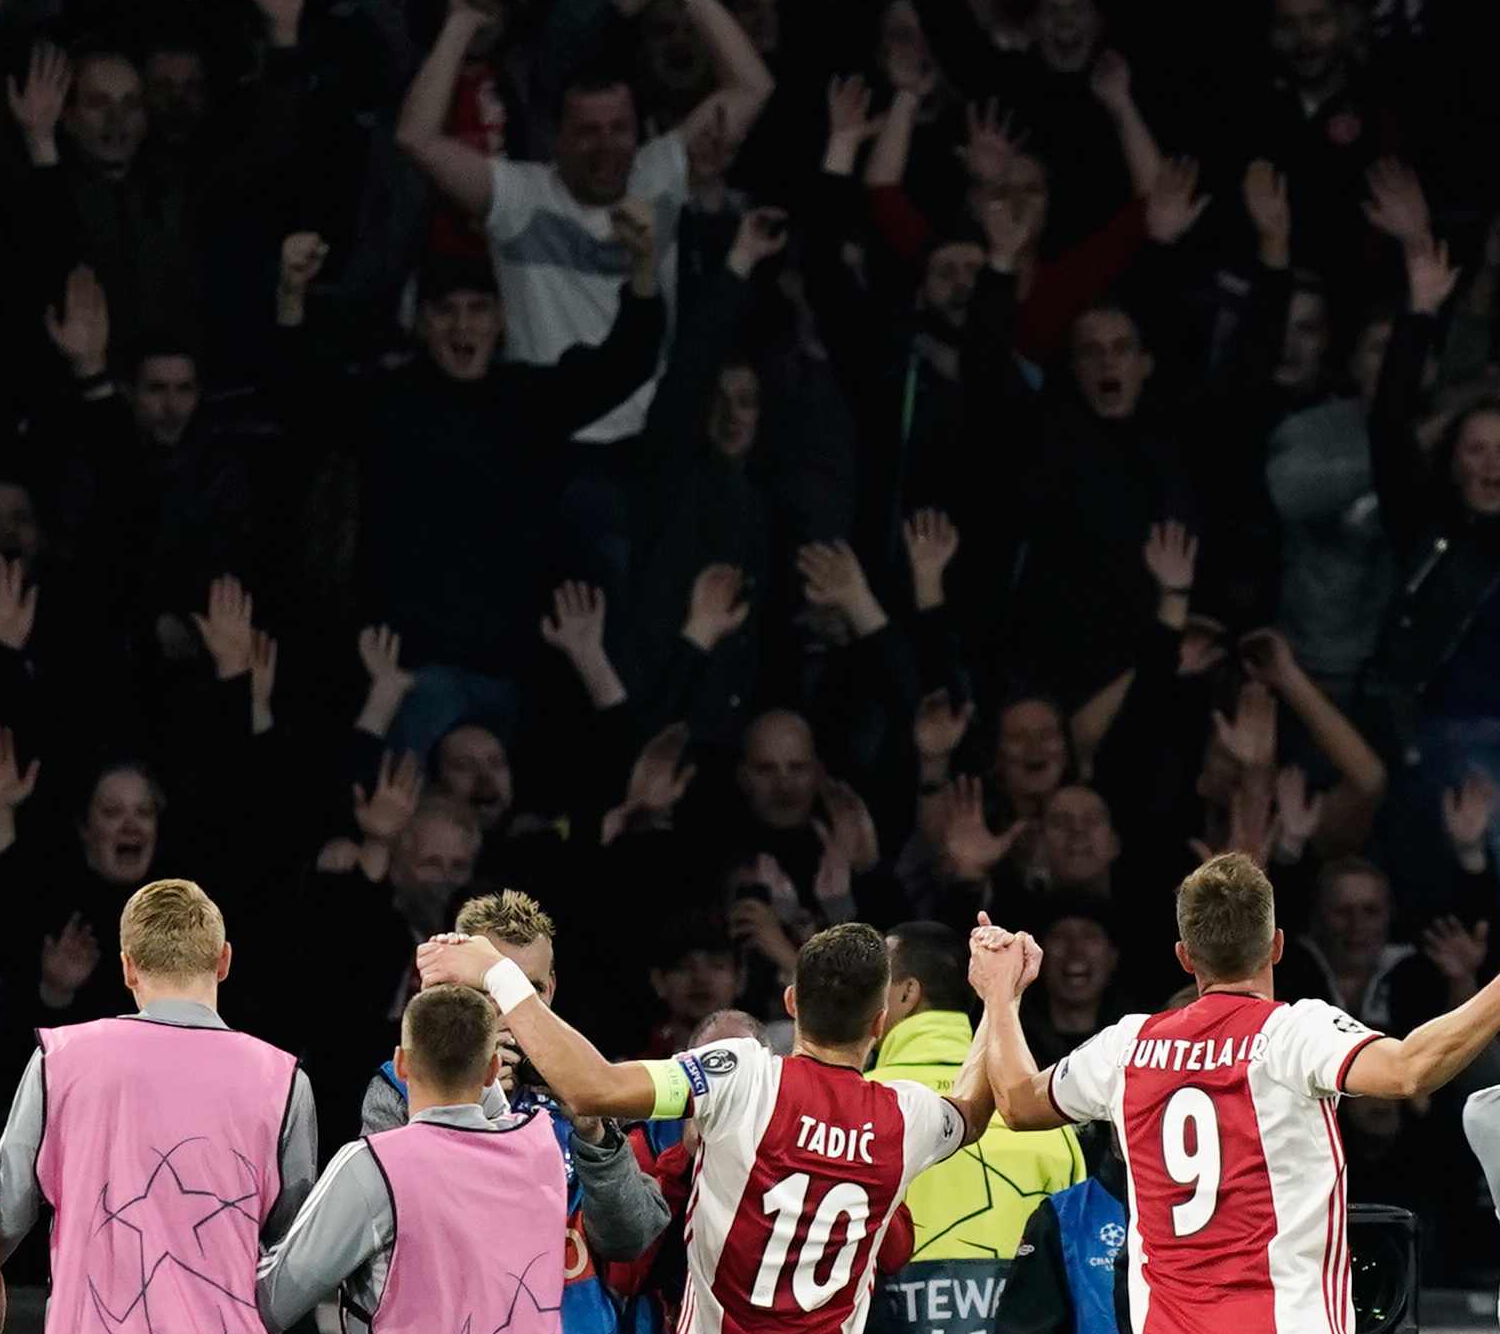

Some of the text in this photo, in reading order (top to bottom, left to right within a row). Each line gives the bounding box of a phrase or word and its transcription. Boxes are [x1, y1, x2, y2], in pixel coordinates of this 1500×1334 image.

[796, 1114, 876, 1165] TADIĆ
[1161, 1085, 1223, 1239] 9
[749, 1171, 871, 1313] 10
[885, 1277, 1007, 1323] TEW
